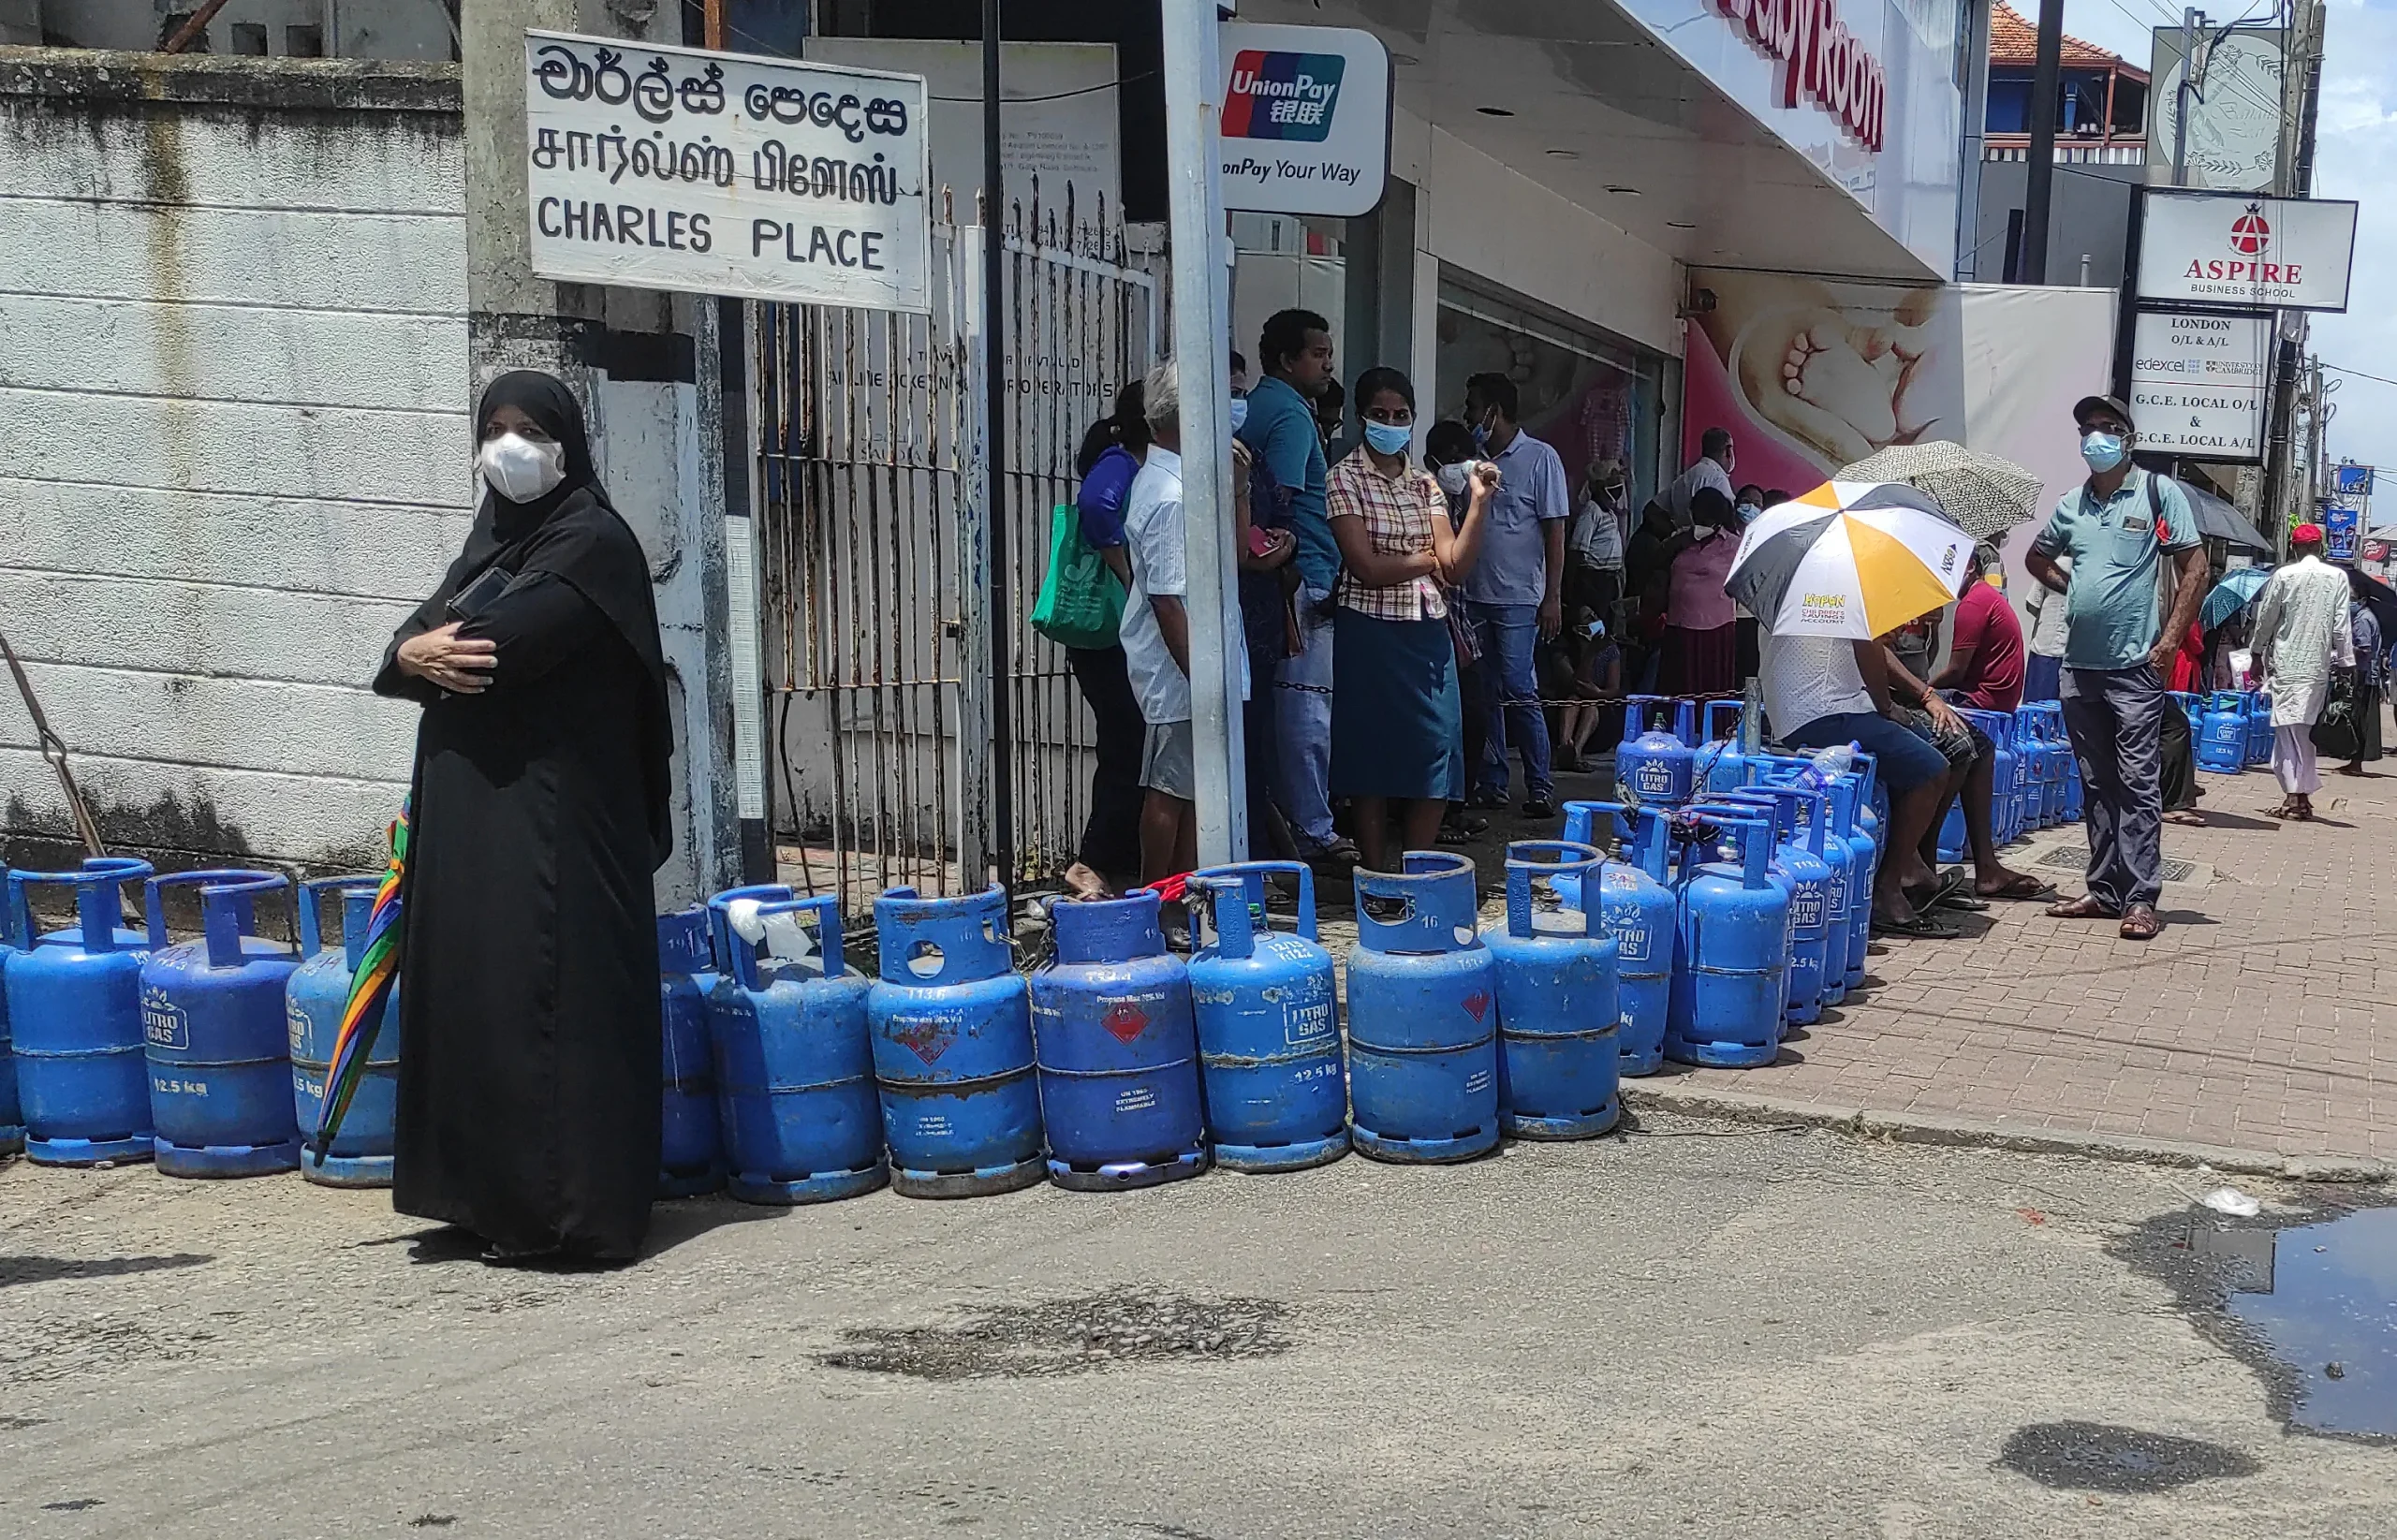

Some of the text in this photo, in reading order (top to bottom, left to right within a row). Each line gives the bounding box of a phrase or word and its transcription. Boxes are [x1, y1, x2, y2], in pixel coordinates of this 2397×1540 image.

[1232, 70, 1336, 106] UnionPay
[744, 83, 908, 143] පෙදෙස
[1270, 100, 1325, 125] 银联
[1222, 158, 1361, 186] onPay Your Way
[537, 197, 884, 271] CHARLES PLACE
[2184, 258, 2302, 285] ASPIRE
[2190, 284, 2296, 298] BUSINESS SCHOOL
[2171, 318, 2231, 330] LONDON
[2171, 334, 2229, 348] O/L & A/L
[2135, 358, 2185, 372] edexcel
[2136, 394, 2258, 413] G.C.E. LOCAL O/L
[2189, 416, 2201, 428] &
[2135, 432, 2256, 449] G.C.E. LOCAL A/L
[1640, 772, 1668, 784] LITRO
[1642, 783, 1664, 792] GAS
[1618, 942, 1639, 956] AS
[1292, 1003, 1329, 1023] LITRO
[147, 1028, 173, 1043] GAS
[1299, 1018, 1327, 1036] GAS
[154, 1078, 180, 1093] 12.5
[306, 1080, 323, 1098] kg
